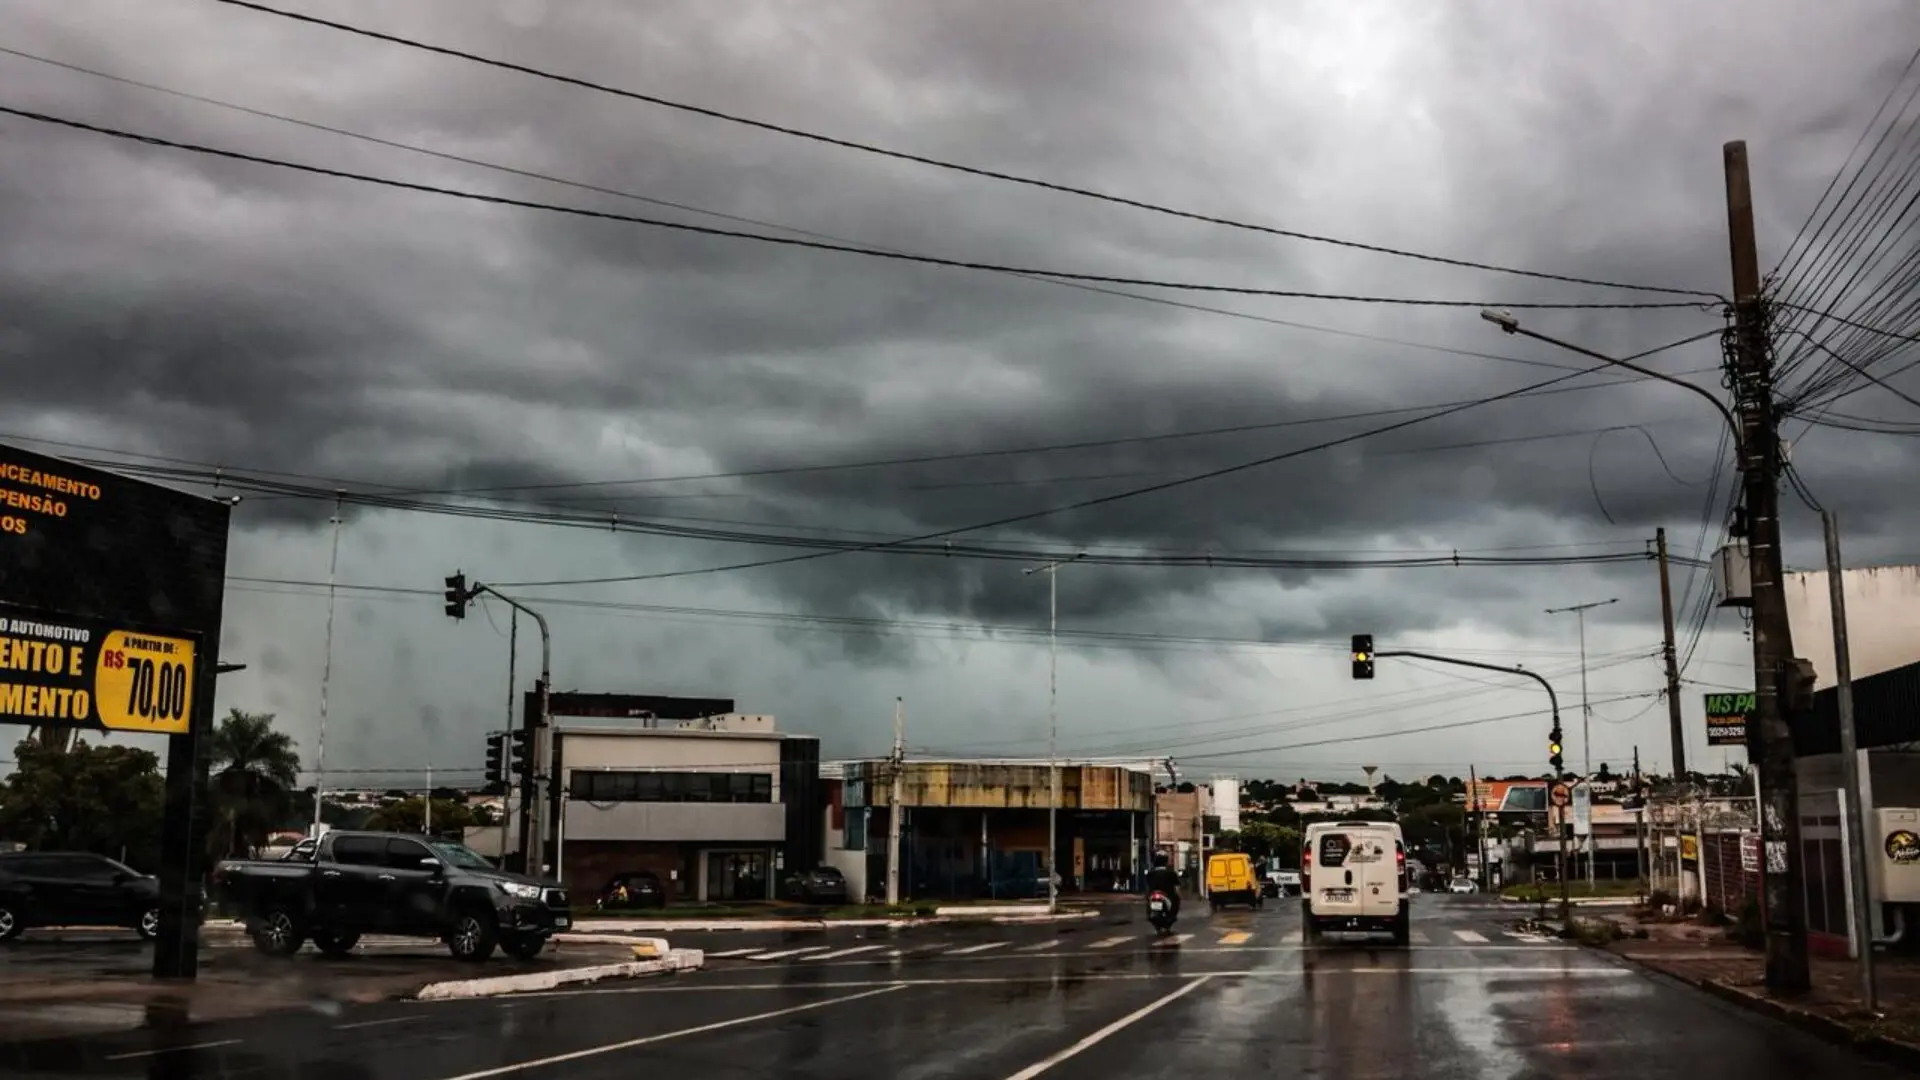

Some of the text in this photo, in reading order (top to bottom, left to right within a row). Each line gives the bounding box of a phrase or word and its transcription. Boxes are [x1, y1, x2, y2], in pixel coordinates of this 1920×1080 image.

[0, 487, 67, 517] PENSÃO
[10, 619, 90, 643] AUTOMOTIVO
[124, 637, 129, 648] A
[133, 639, 162, 652] PARTIR
[0, 636, 85, 677] ENTO E
[0, 680, 90, 721] MENTO
[103, 649, 187, 723] R$ 70,00
[1706, 695, 1733, 714] MS
